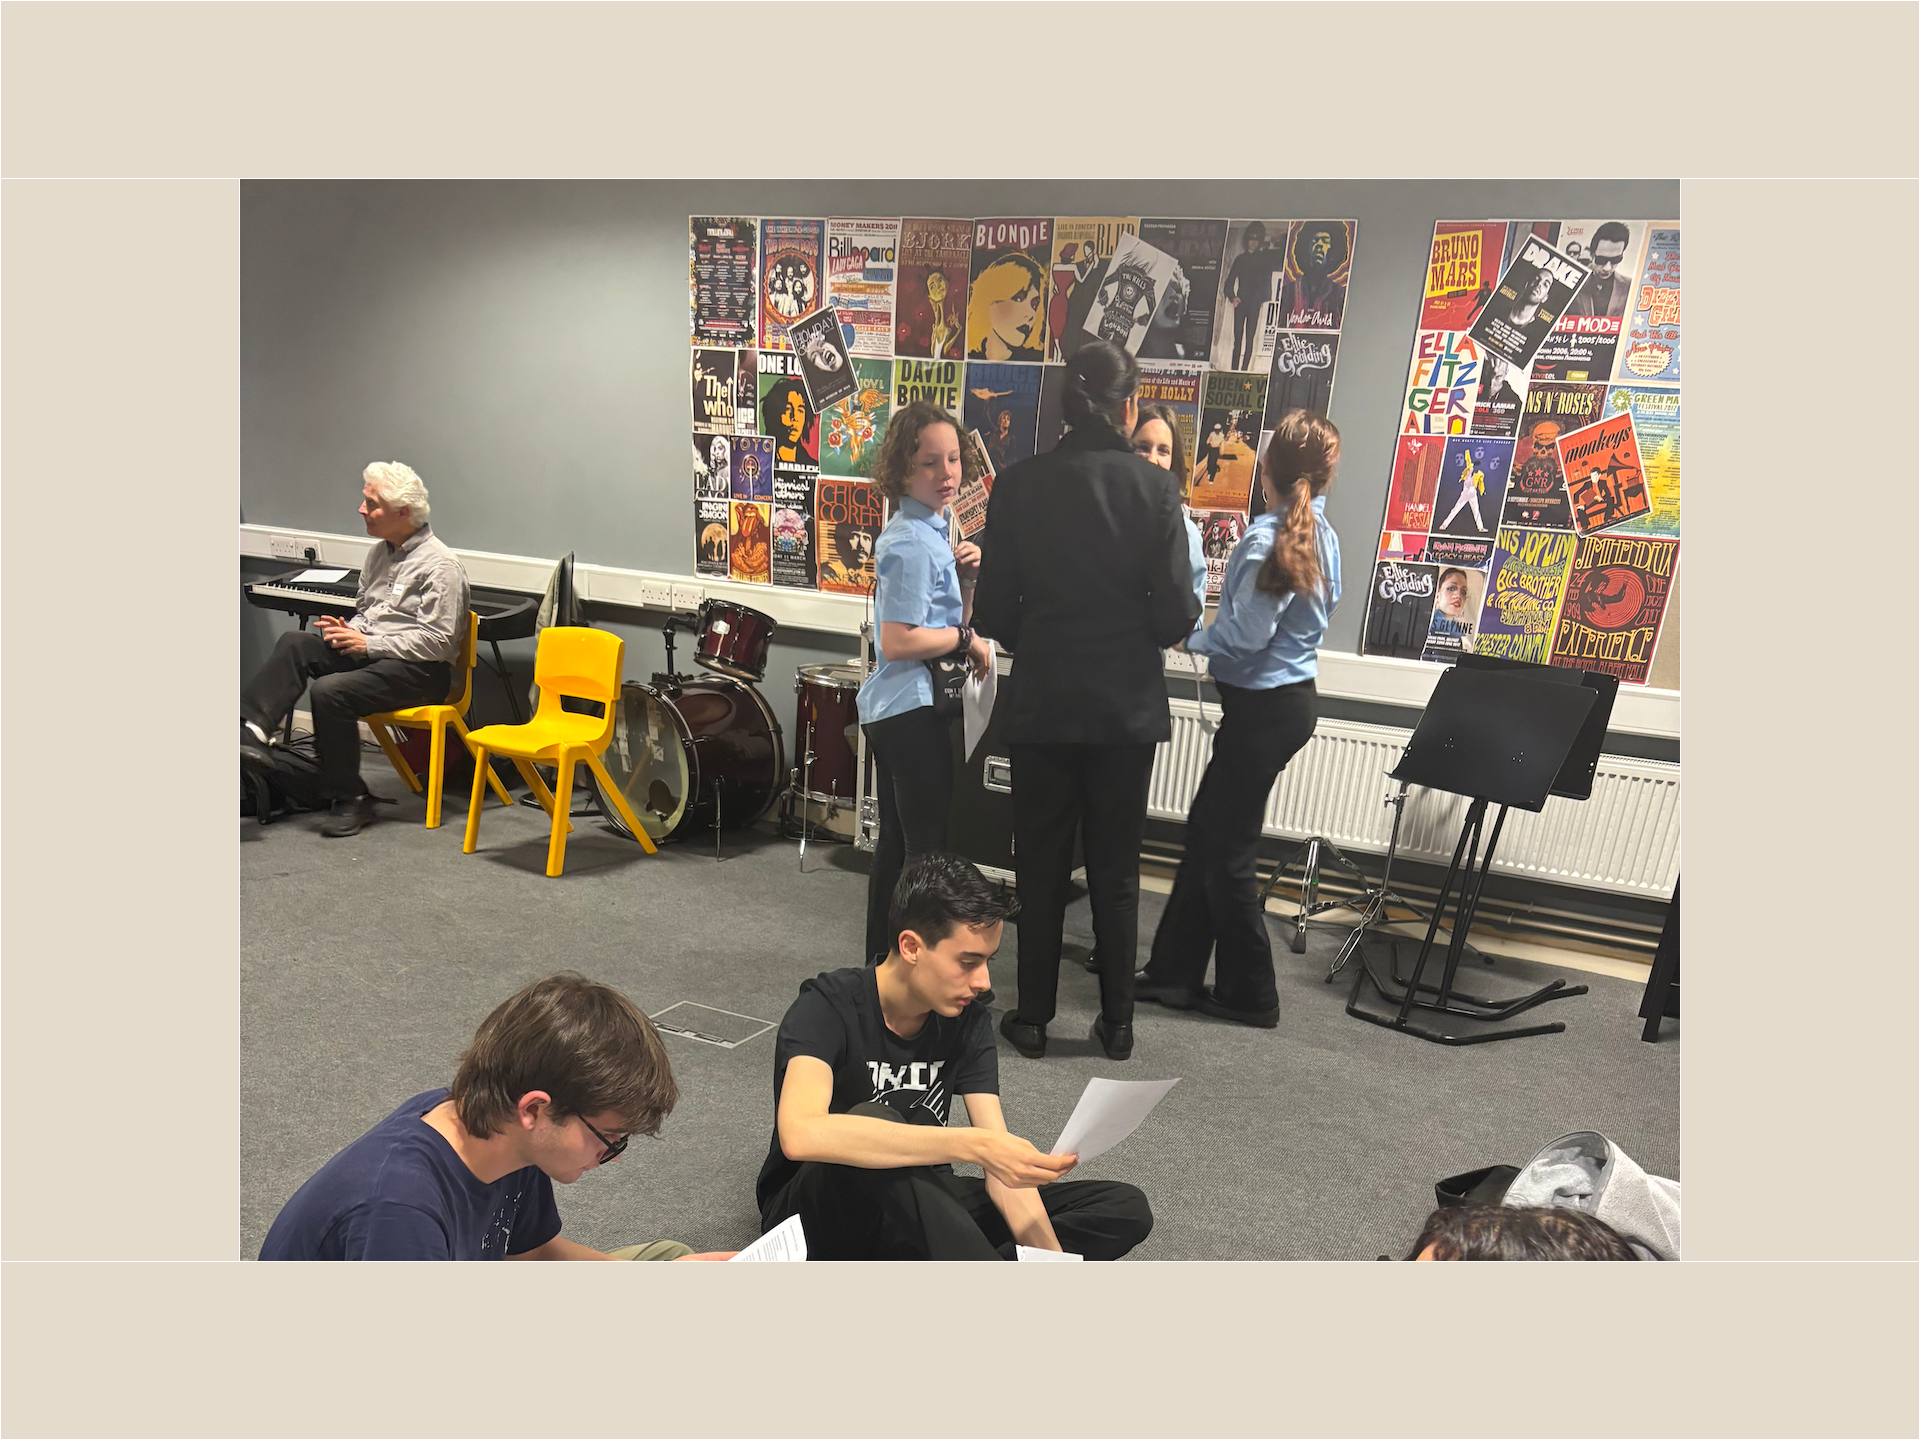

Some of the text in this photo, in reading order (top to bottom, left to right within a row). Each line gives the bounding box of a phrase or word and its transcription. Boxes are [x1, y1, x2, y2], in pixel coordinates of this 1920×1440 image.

[976, 221, 1048, 250] BLONDIE
[829, 236, 897, 263] Billboard
[1431, 234, 1479, 265] BRUNO
[832, 254, 864, 274] LADY GAGA
[1430, 260, 1477, 291] MARS
[1522, 242, 1583, 290] DRAKE
[1104, 319, 1129, 338] LONDON
[1578, 335, 1617, 346] 2005/2006
[1281, 334, 1309, 352] Ellie
[1418, 332, 1479, 361] ELLA
[1570, 348, 1588, 356] 20:00
[759, 354, 784, 374] ONE
[901, 360, 955, 384] DAVID
[1278, 343, 1332, 377] Goulding
[1412, 354, 1478, 388] FITZ
[1160, 386, 1195, 402] HOLLY
[1208, 376, 1251, 393] BUENA
[897, 384, 957, 410] BOWIE
[1206, 391, 1252, 408] SOCIAL
[1408, 387, 1470, 415] GER
[1492, 402, 1516, 410] LAMAR
[1557, 391, 1594, 415] ROSES
[1634, 394, 1665, 404] GREEN
[1638, 403, 1664, 411] FESTIVAL
[1564, 426, 1632, 464] monkeys
[820, 484, 880, 509] CHICK
[819, 503, 883, 527] COREA
[1519, 531, 1571, 568] JOPLIN
[1382, 563, 1411, 580] Ellie
[1570, 570, 1594, 588] 24
[1379, 573, 1433, 603] Goulding
[1496, 568, 1561, 600] BIG BROTHER
[1563, 602, 1582, 621] 1969
[1440, 619, 1474, 635] GLYNNE
[1554, 619, 1655, 664] EXPERIENCE
[1625, 662, 1646, 681] HALL
